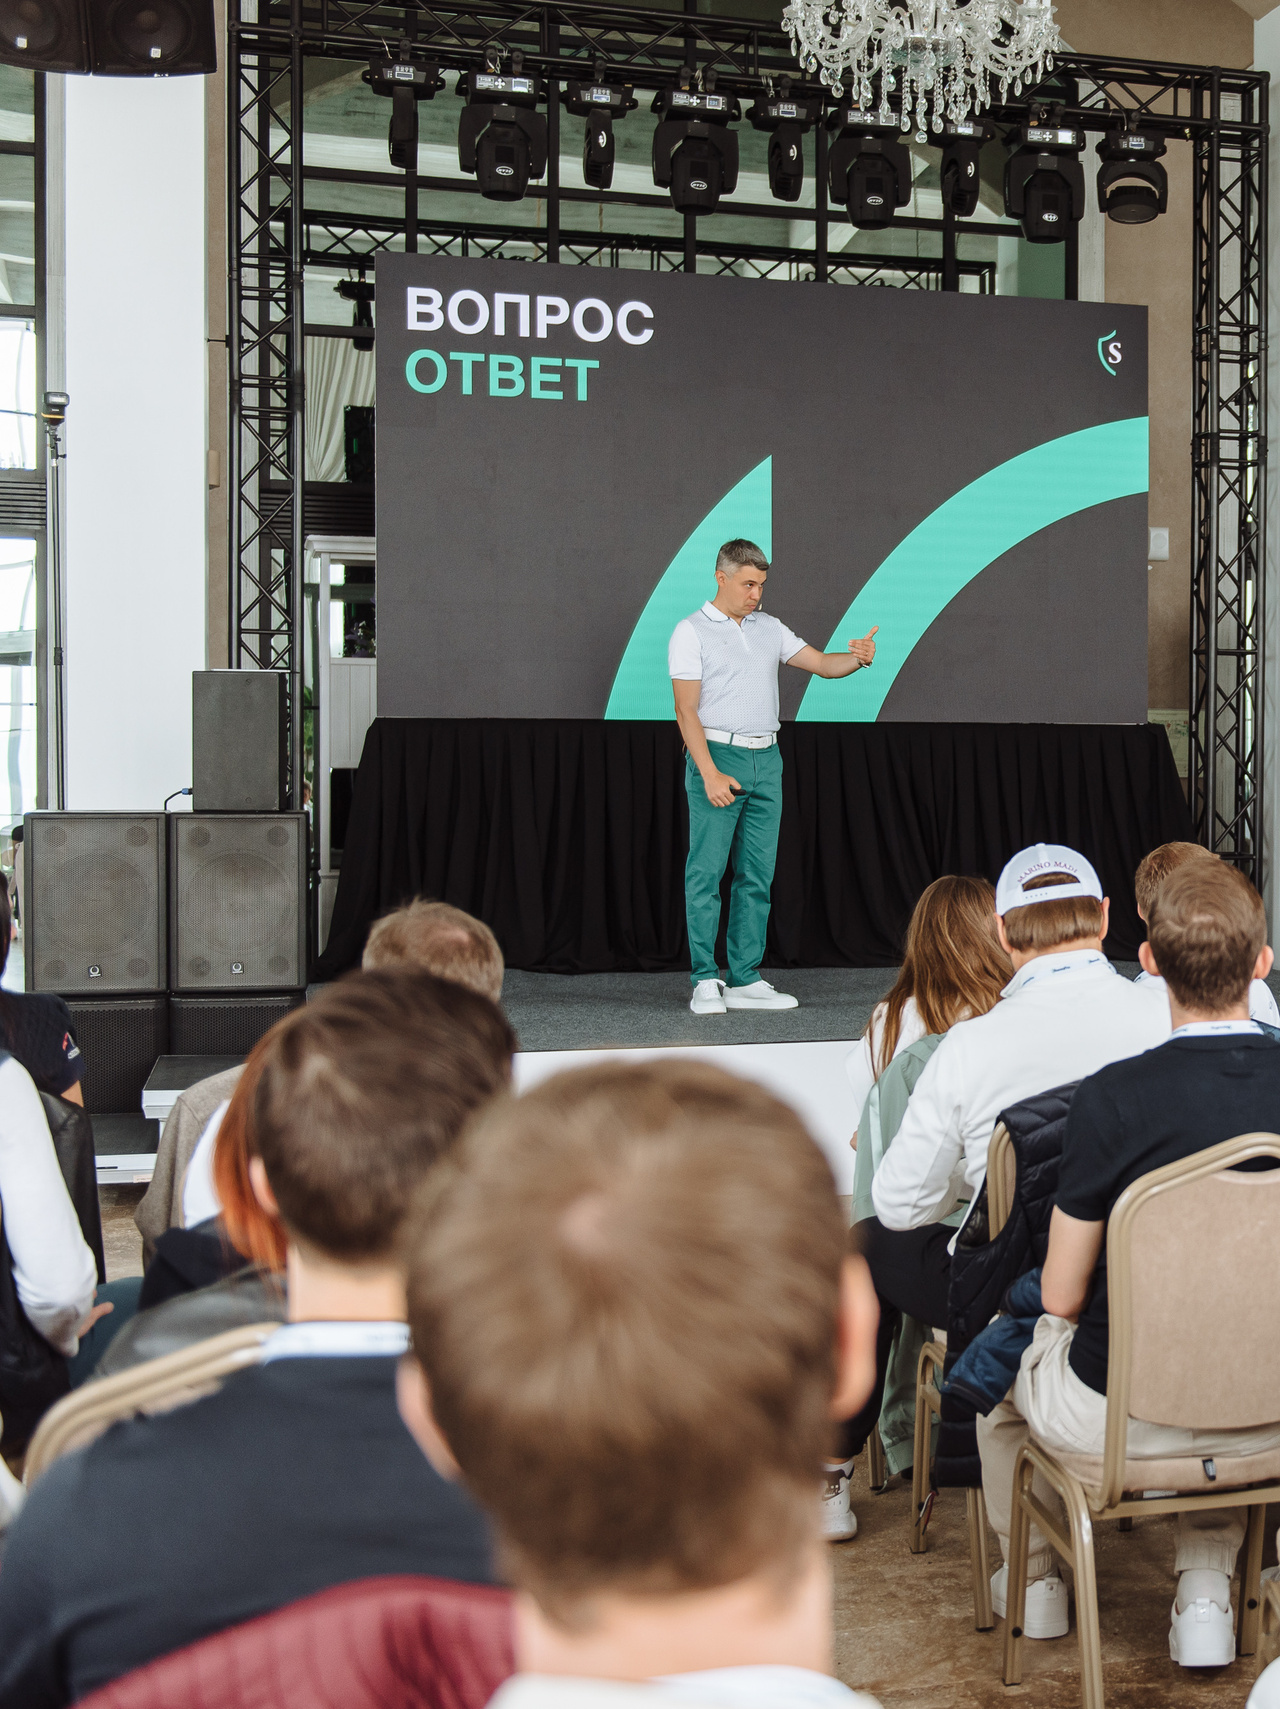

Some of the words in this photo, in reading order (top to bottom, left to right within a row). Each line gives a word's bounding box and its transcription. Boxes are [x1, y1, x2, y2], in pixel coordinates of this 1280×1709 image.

[407, 286, 654, 345] ВОПРОС
[1108, 342, 1122, 364] S
[405, 349, 600, 401] ОТВЕТ
[1017, 861, 1051, 883] MARINO
